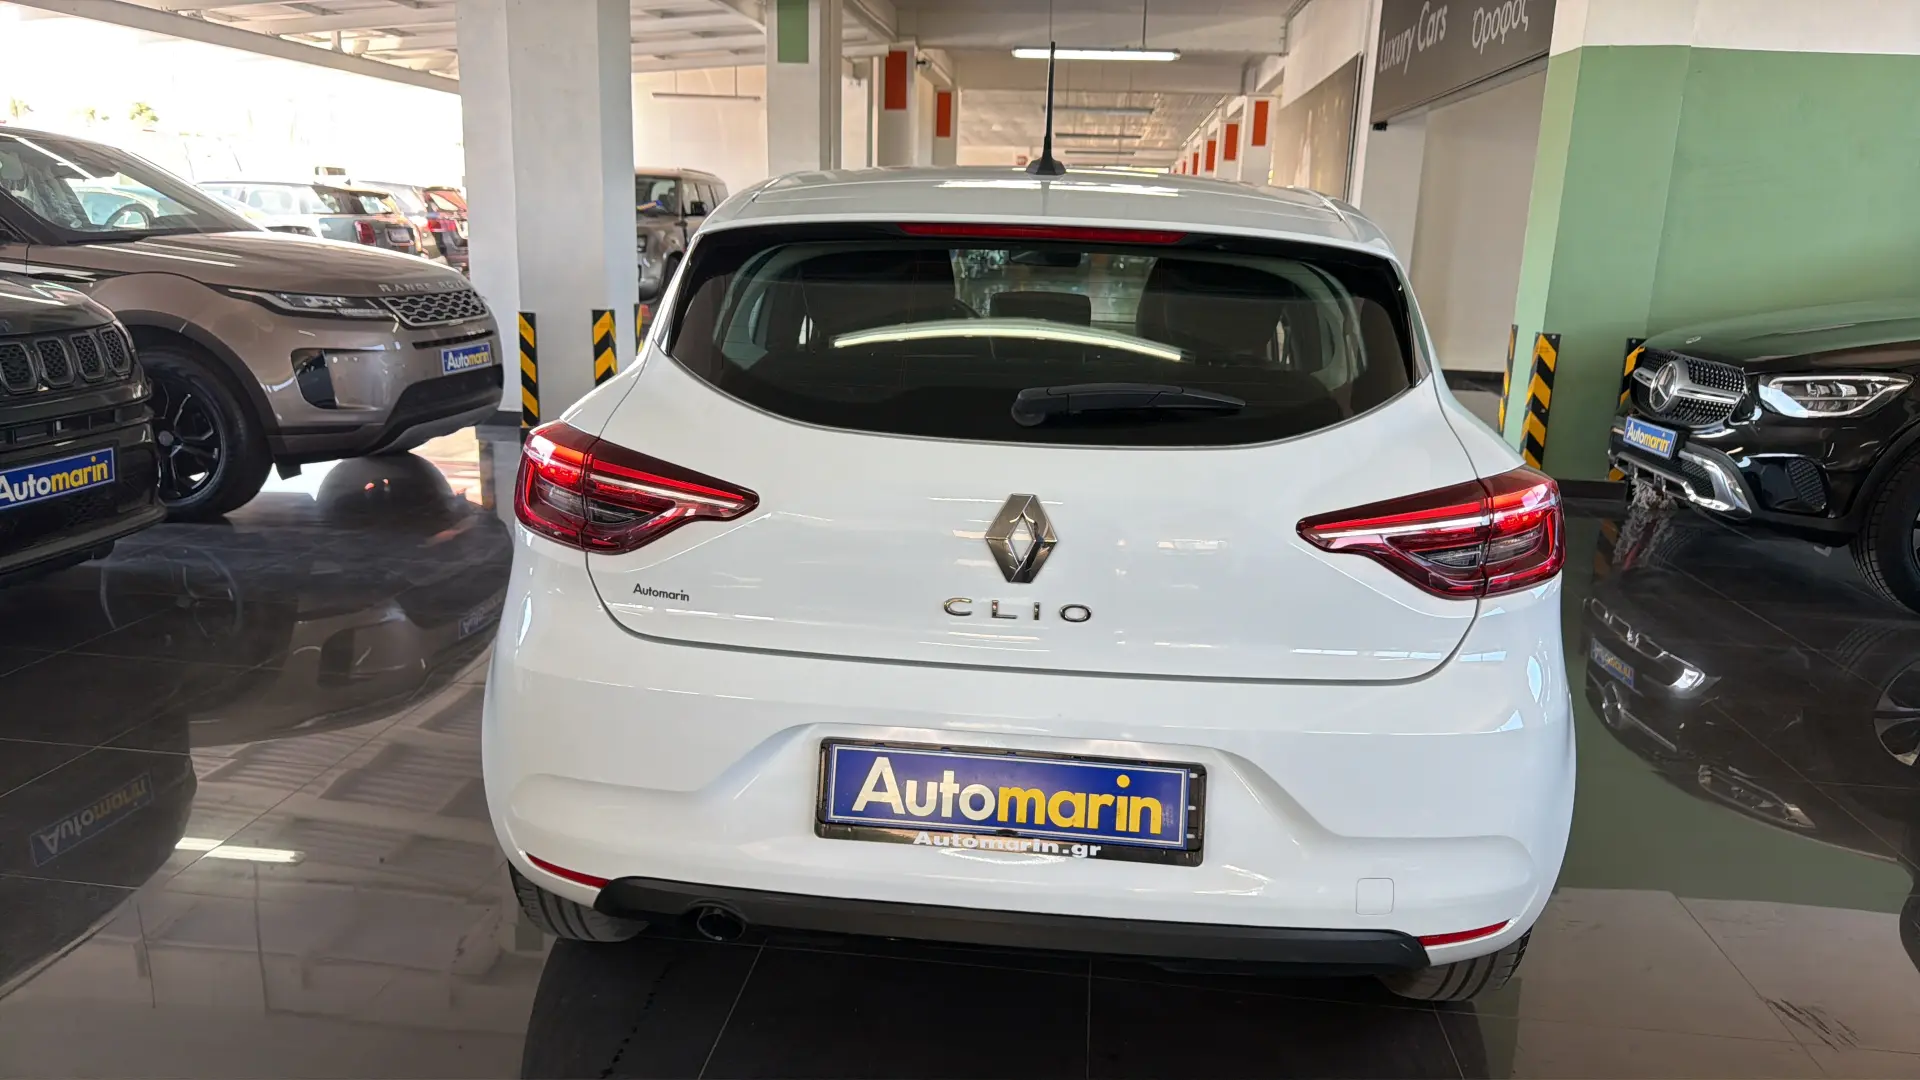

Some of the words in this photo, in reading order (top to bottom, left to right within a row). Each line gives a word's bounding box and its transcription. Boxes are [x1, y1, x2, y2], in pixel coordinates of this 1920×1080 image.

[1379, 24, 1416, 76] Luxury
[1417, 1, 1448, 51] Cars
[447, 346, 489, 371] Automarin
[1626, 421, 1670, 453] Automarin
[0, 455, 108, 502] Automarin
[633, 583, 690, 602] Automarin
[943, 597, 1092, 623] CLIO
[852, 756, 1163, 834] Automarin
[913, 831, 1102, 858] Automarin.gr
